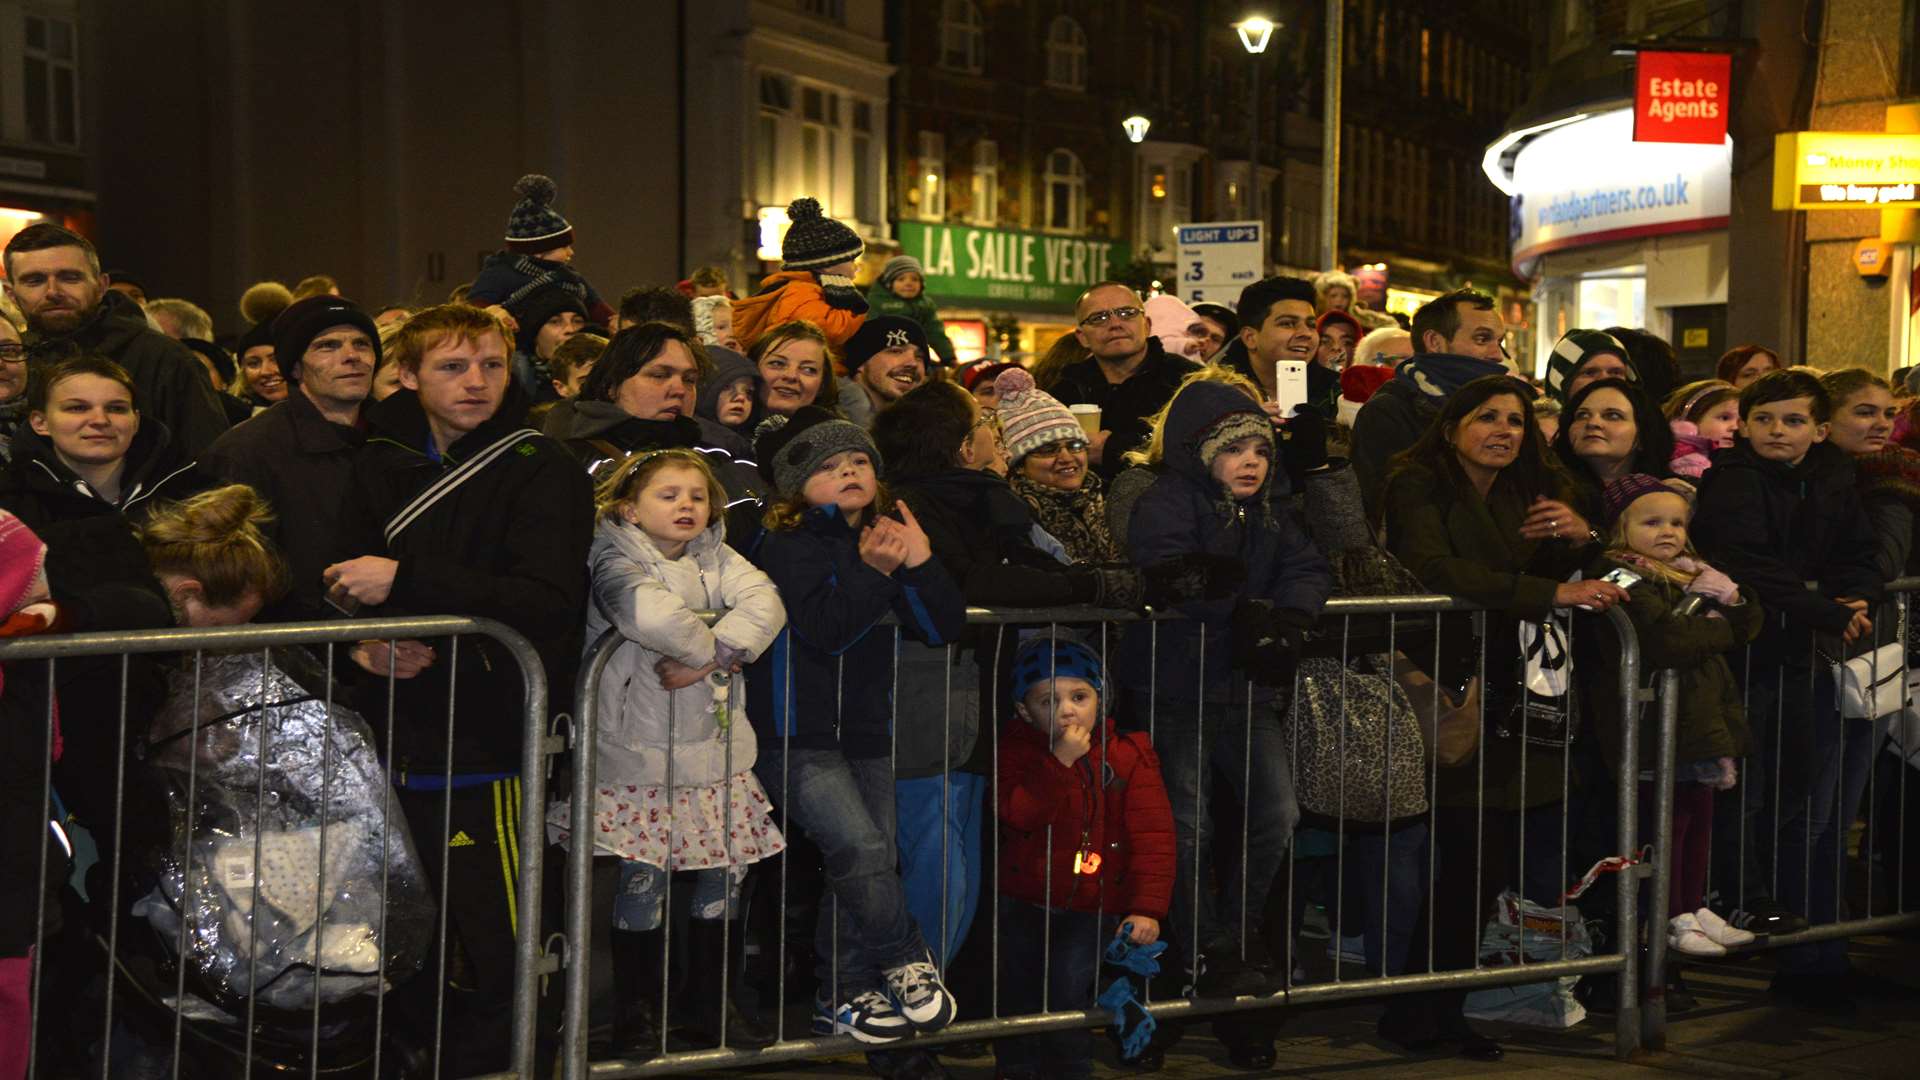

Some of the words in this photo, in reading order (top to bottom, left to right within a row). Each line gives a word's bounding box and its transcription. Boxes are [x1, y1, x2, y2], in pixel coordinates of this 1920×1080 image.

[1650, 77, 1718, 98] Estate
[1648, 98, 1719, 122] Agents
[1829, 155, 1883, 171] Money
[1820, 184, 1846, 201] We
[1847, 184, 1878, 204] buy
[1878, 184, 1915, 204] gold
[1184, 230, 1220, 242] LIGHT
[1227, 228, 1255, 241] UP'S
[923, 226, 955, 276] LA
[966, 230, 1035, 282] SALLE
[1043, 237, 1112, 284] VERTE
